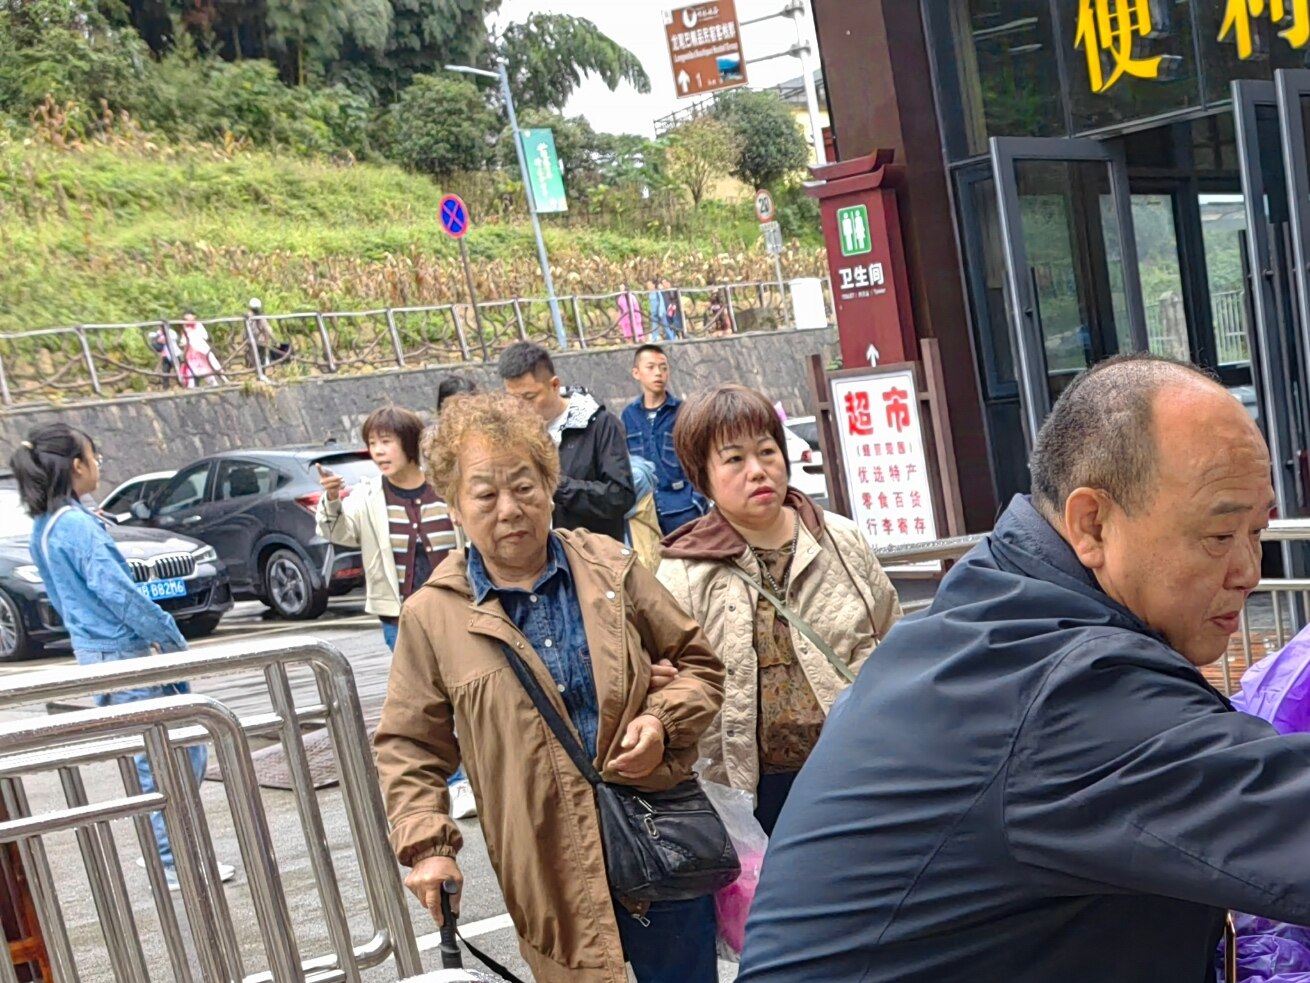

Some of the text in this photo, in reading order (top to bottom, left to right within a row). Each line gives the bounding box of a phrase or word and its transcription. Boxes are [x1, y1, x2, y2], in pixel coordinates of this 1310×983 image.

[838, 262, 885, 290] 卫生间
[844, 386, 911, 436] 超市
[858, 464, 917, 484] 优选特产
[862, 491, 922, 509] 零食百货
[866, 518, 926, 536] 行李寄存
